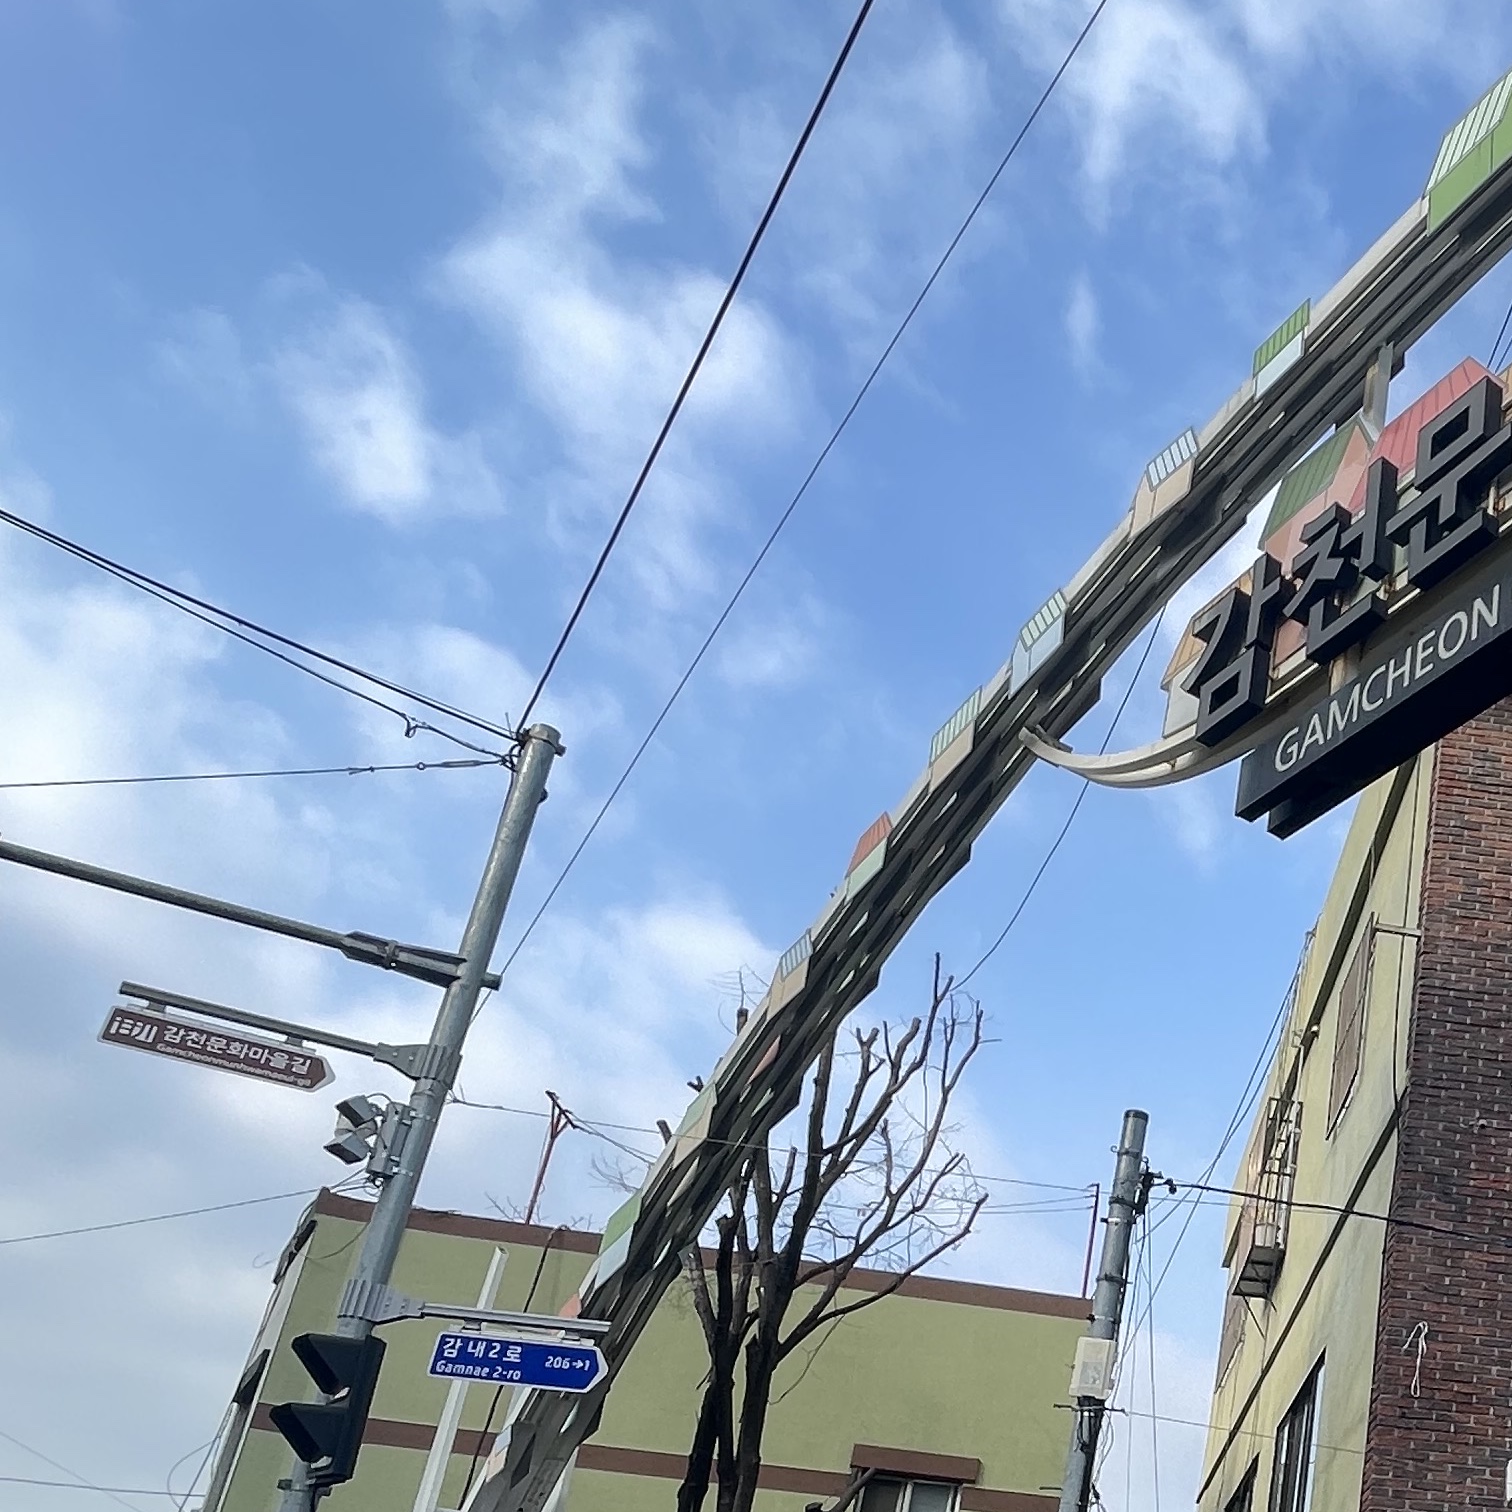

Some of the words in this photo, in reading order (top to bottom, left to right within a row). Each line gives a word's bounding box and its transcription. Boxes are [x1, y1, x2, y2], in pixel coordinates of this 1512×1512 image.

[1274, 583, 1500, 773] GAMCHEON
[163, 1024, 311, 1075] 감천문화마을길
[435, 1359, 490, 1378] Gamnae
[492, 1365, 522, 1381] 2-ro
